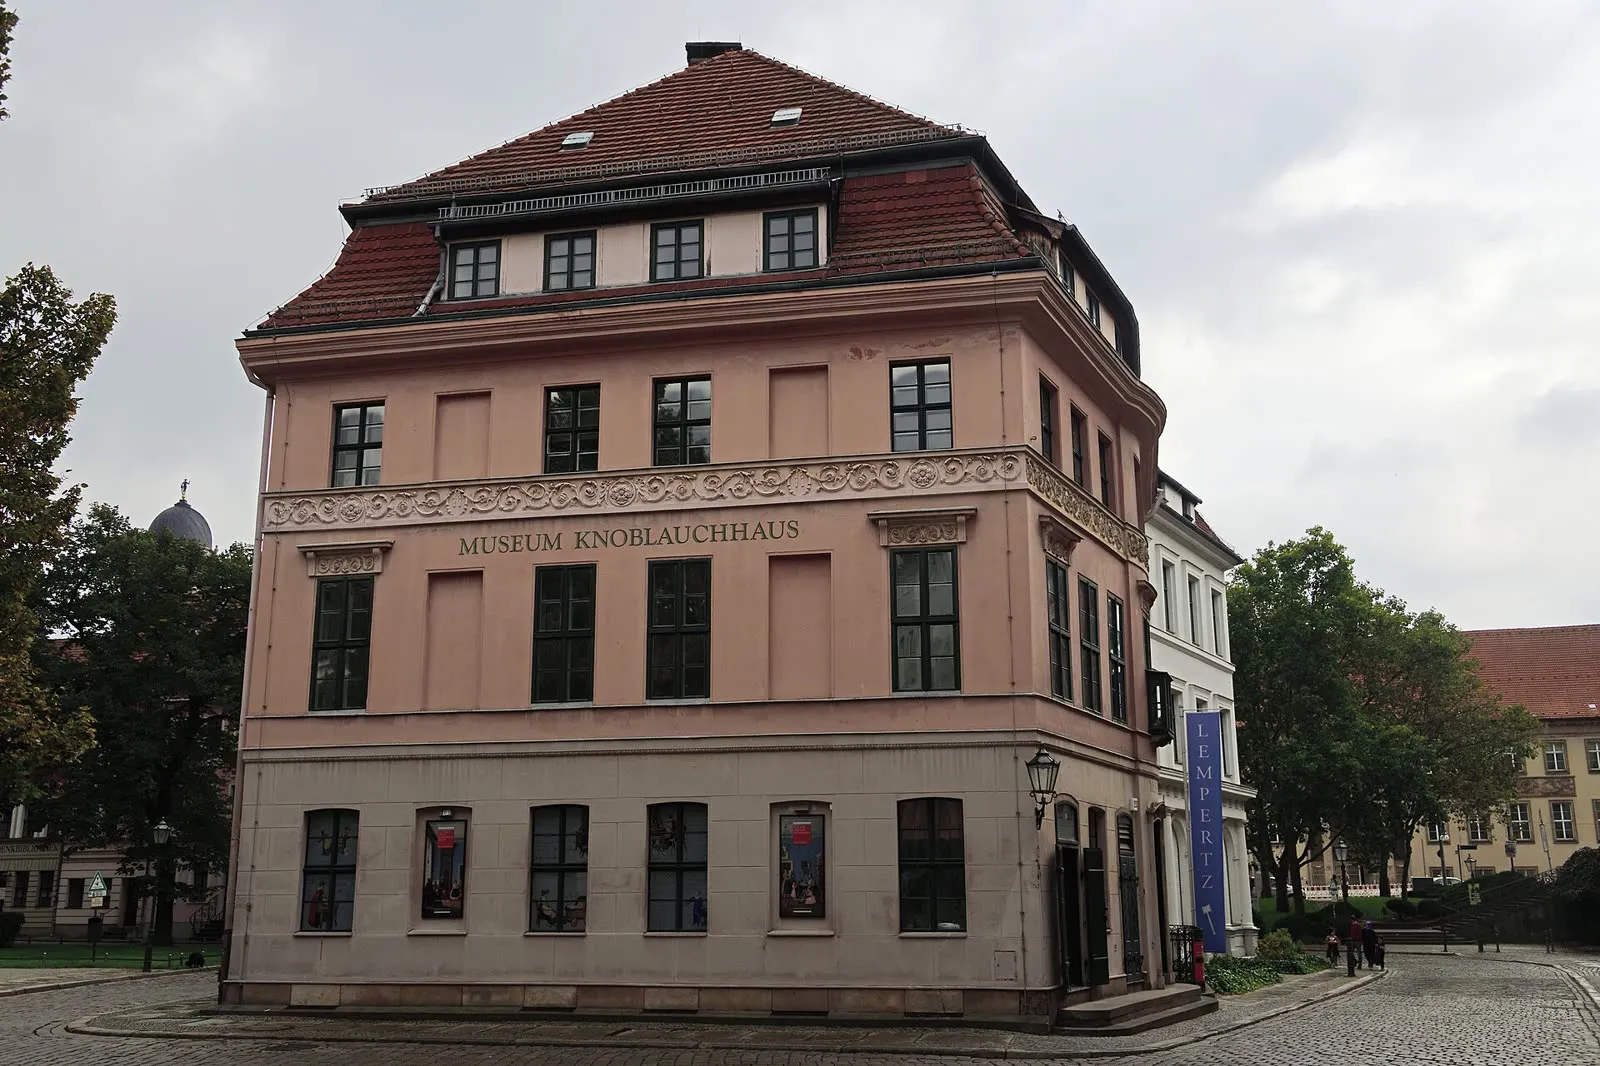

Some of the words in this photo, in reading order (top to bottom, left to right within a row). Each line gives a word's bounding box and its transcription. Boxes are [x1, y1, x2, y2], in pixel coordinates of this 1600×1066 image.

[459, 533, 563, 555] MUSEUM
[575, 520, 799, 549] KNOBLAUCHHAUS
[1196, 724, 1213, 888] LEMPERTZ
